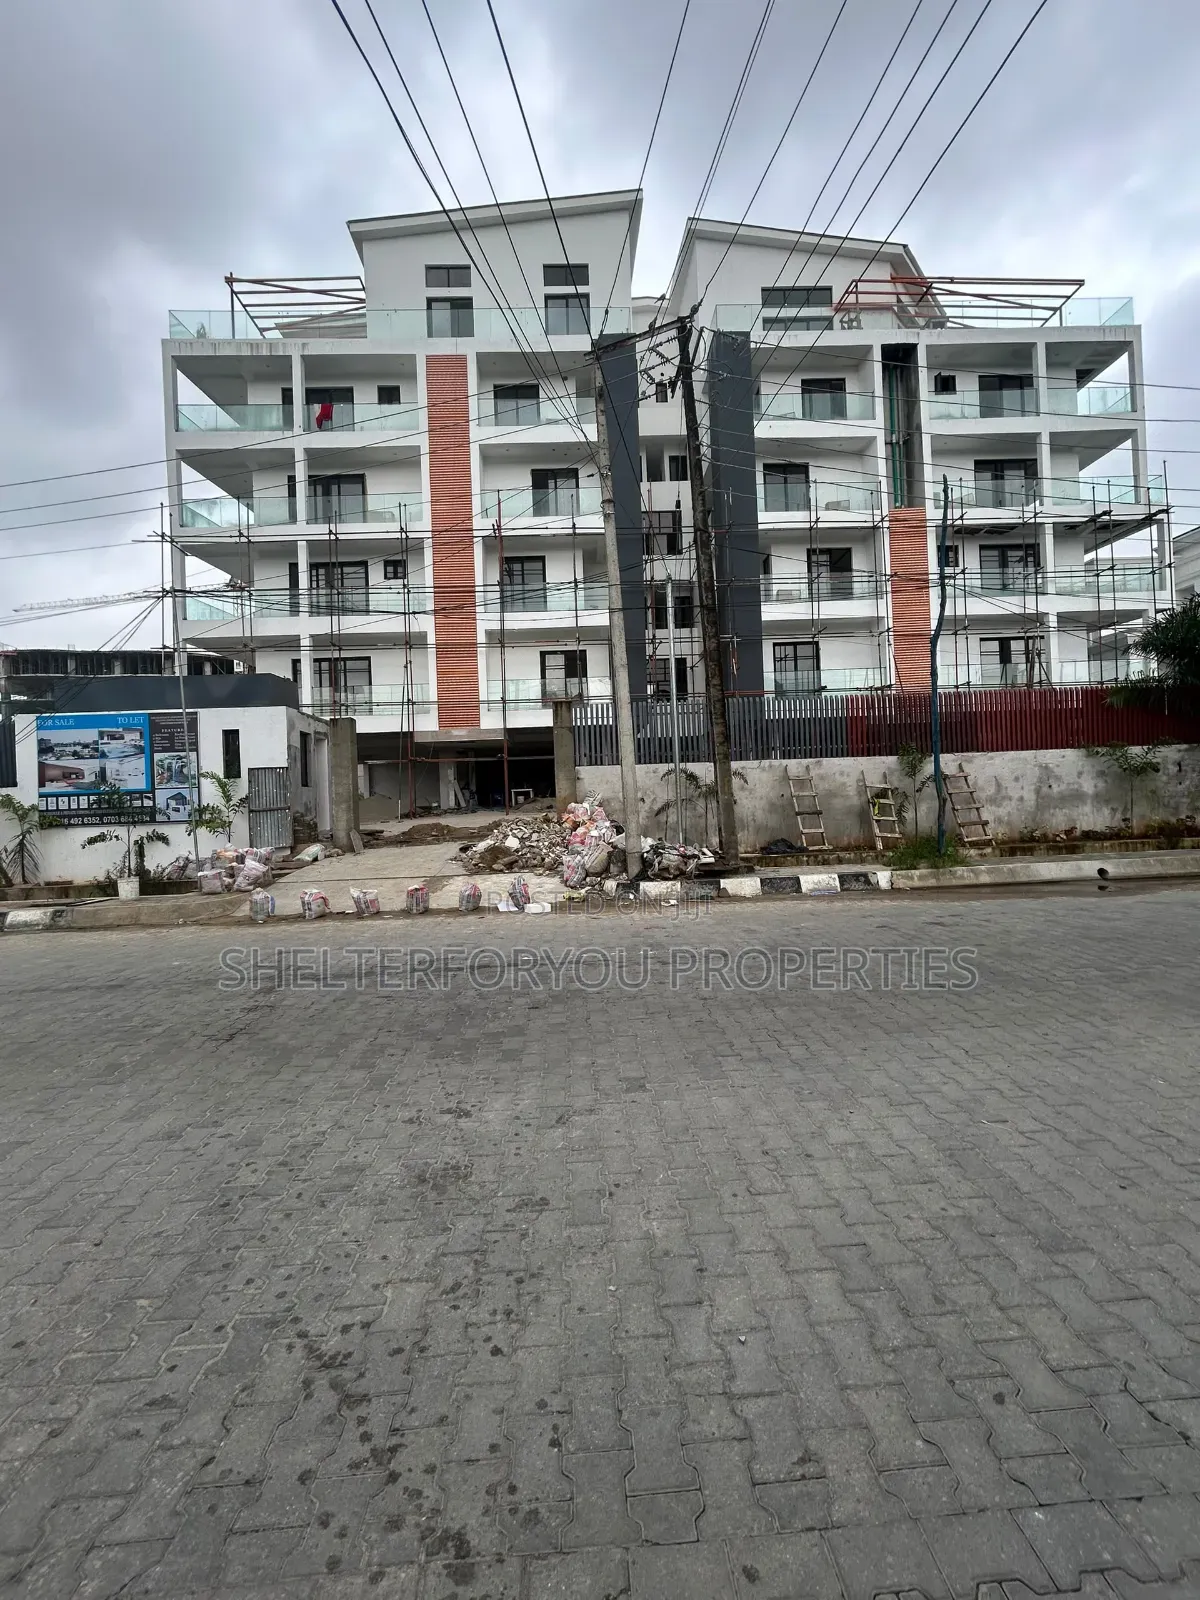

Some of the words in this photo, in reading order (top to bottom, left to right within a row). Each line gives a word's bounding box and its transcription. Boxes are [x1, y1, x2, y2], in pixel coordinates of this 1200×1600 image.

[37, 719, 53, 727] FOR
[54, 718, 75, 726] SALE
[116, 716, 128, 724] TO
[129, 716, 145, 724] LET
[70, 817, 83, 825] 492
[103, 815, 119, 823] 0703
